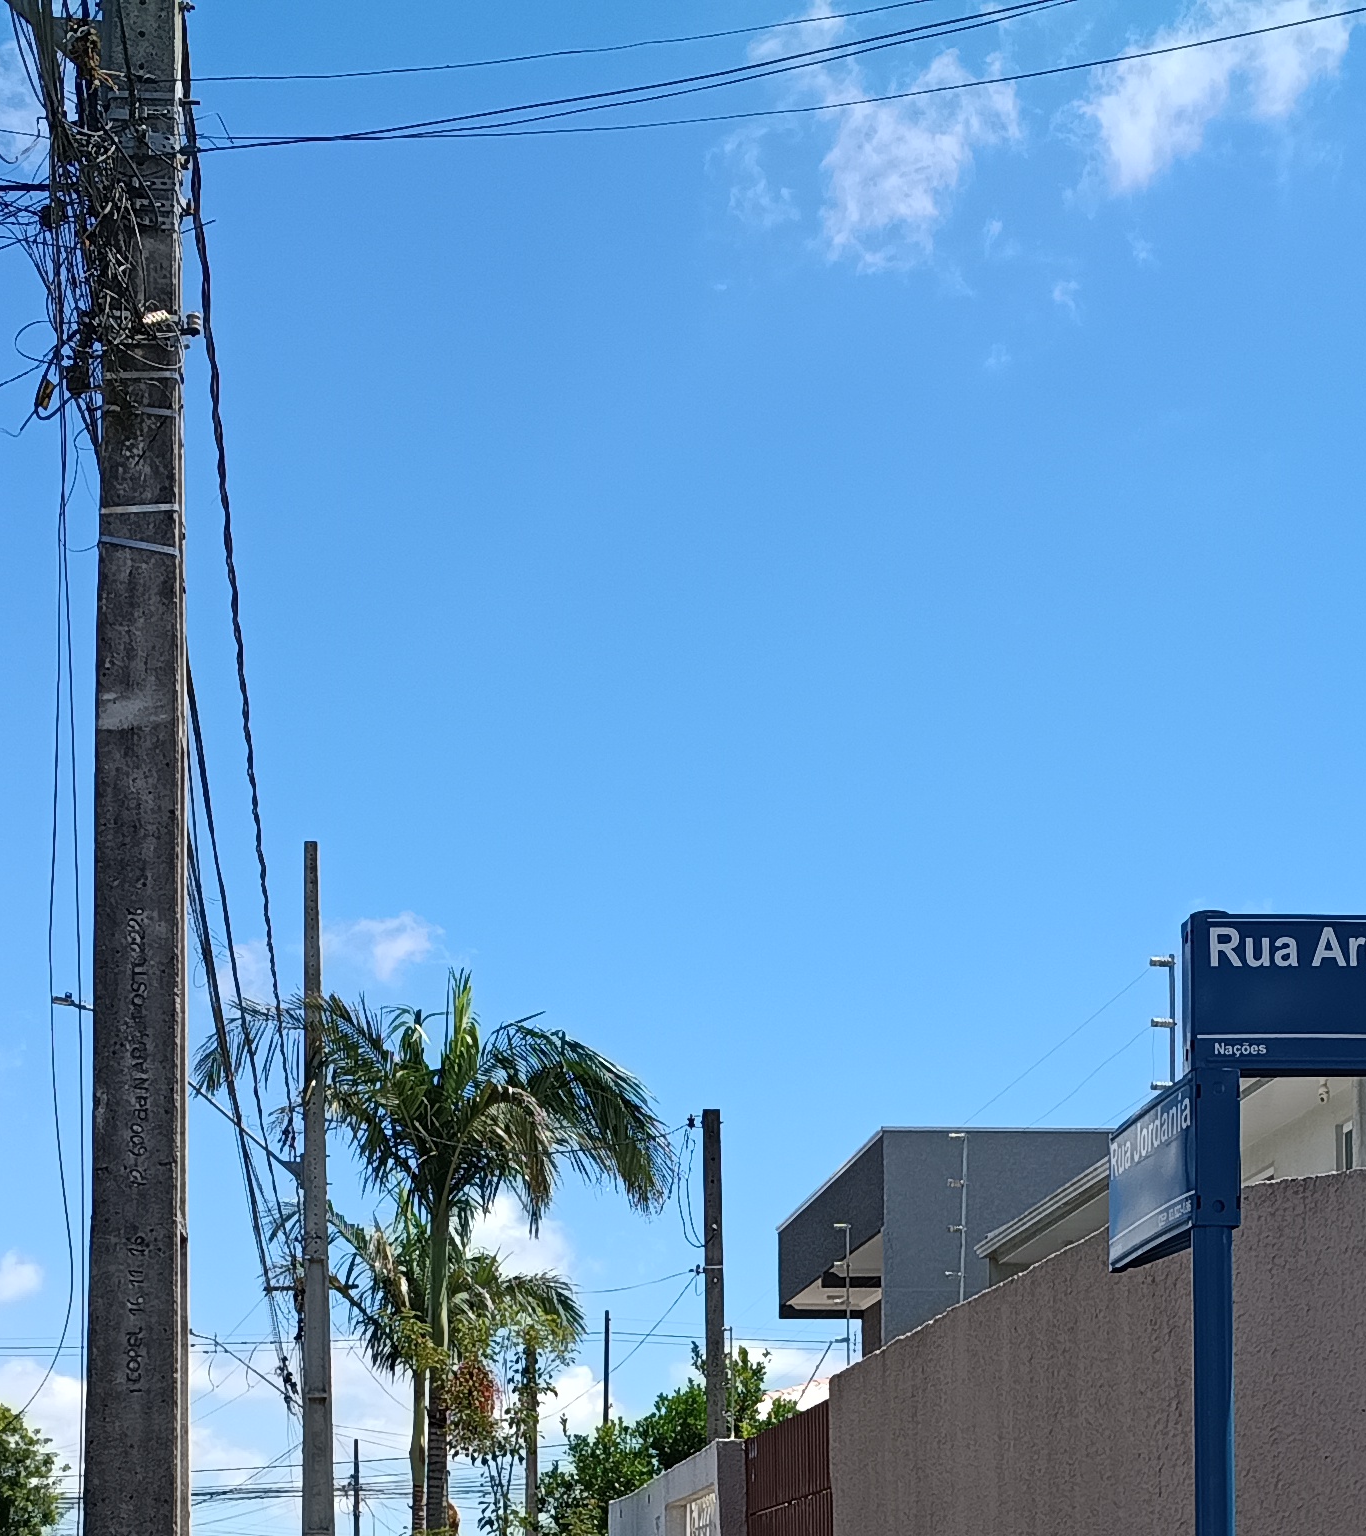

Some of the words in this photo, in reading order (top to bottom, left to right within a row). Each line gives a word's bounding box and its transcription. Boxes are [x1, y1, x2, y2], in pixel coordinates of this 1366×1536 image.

[1209, 926, 1299, 968] Rua
[1213, 1042, 1267, 1058] Nações
[1110, 1140, 1131, 1181] Rua
